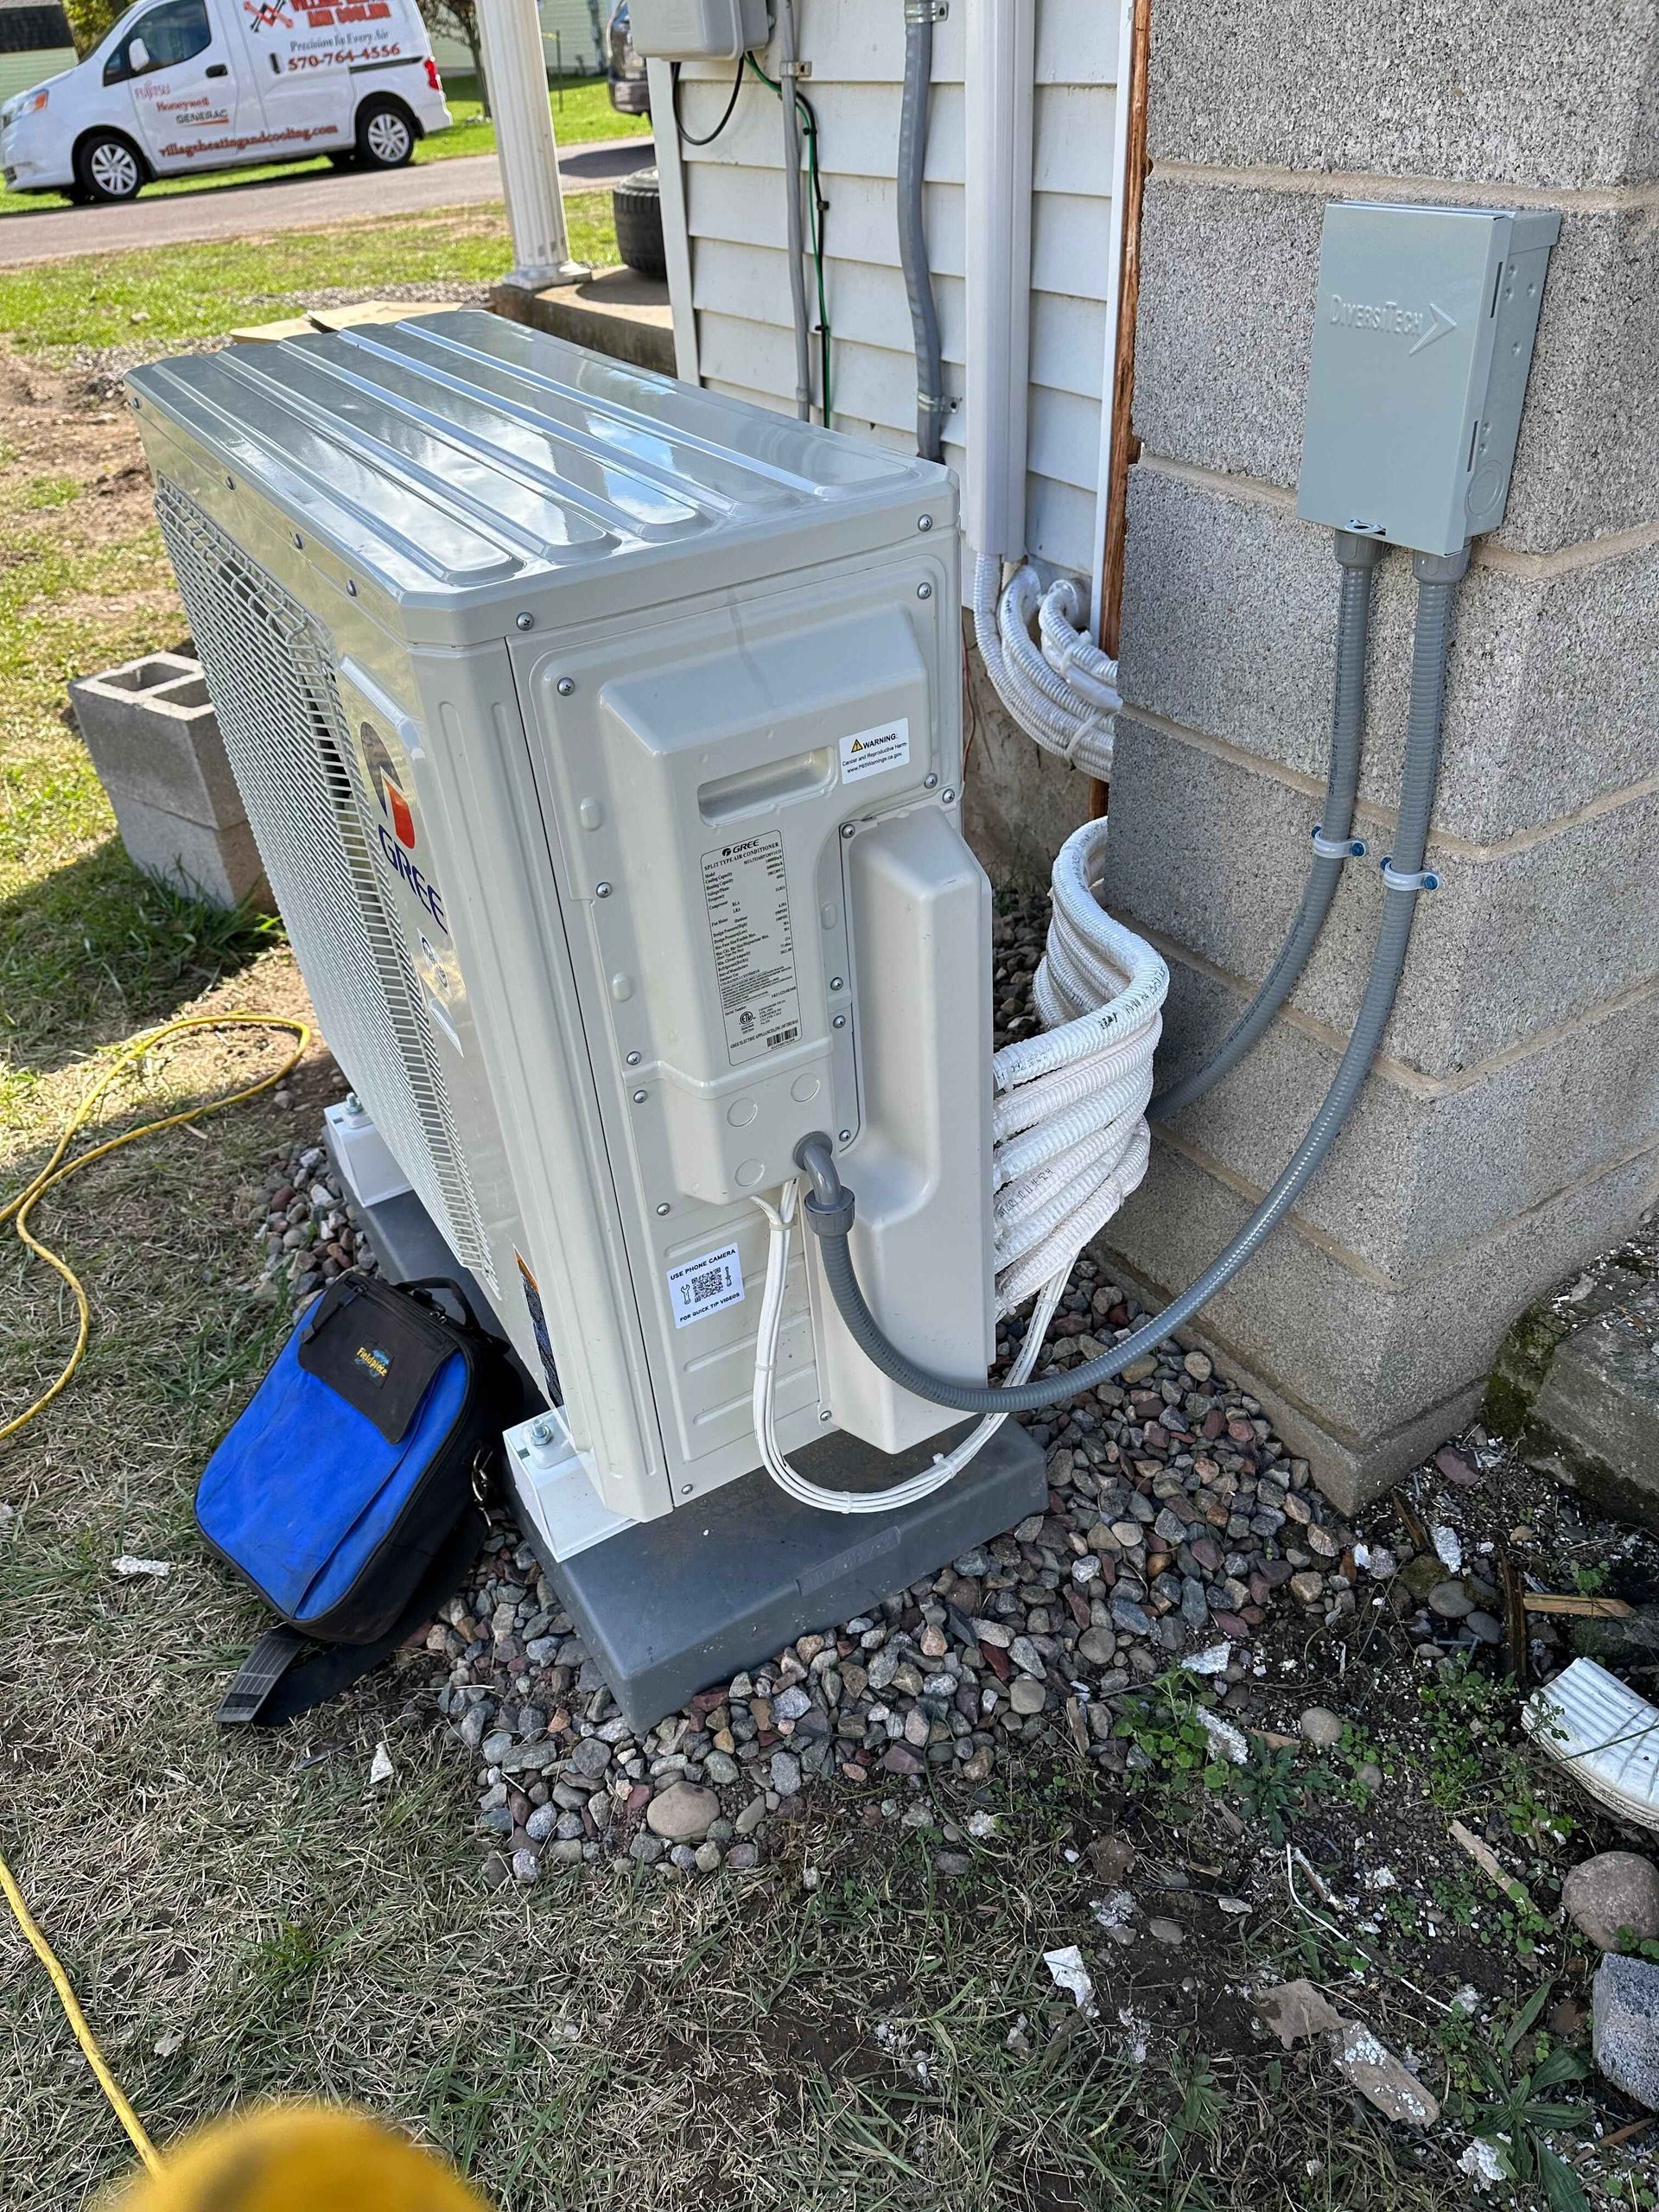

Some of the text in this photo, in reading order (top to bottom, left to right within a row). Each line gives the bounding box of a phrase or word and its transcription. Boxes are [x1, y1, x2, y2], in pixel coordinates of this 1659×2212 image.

[288, 43, 401, 72] 570-764-4556
[156, 97, 210, 111] Honeywell
[175, 109, 228, 124] GENERAC
[863, 733, 899, 749] WARNING:
[704, 861, 719, 871] SPLIT
[720, 857, 733, 866] TYPE
[743, 842, 779, 858] CONDITIONER
[733, 839, 760, 854] GREE
[378, 823, 448, 935] GREE
[671, 1249, 735, 1280] USE PHONE CAMERA
[680, 1313, 691, 1322] FOR
[692, 1306, 709, 1316] QUICK
[720, 1293, 740, 1304] VIDEOS
[357, 1347, 387, 1376] Fieldpiece
